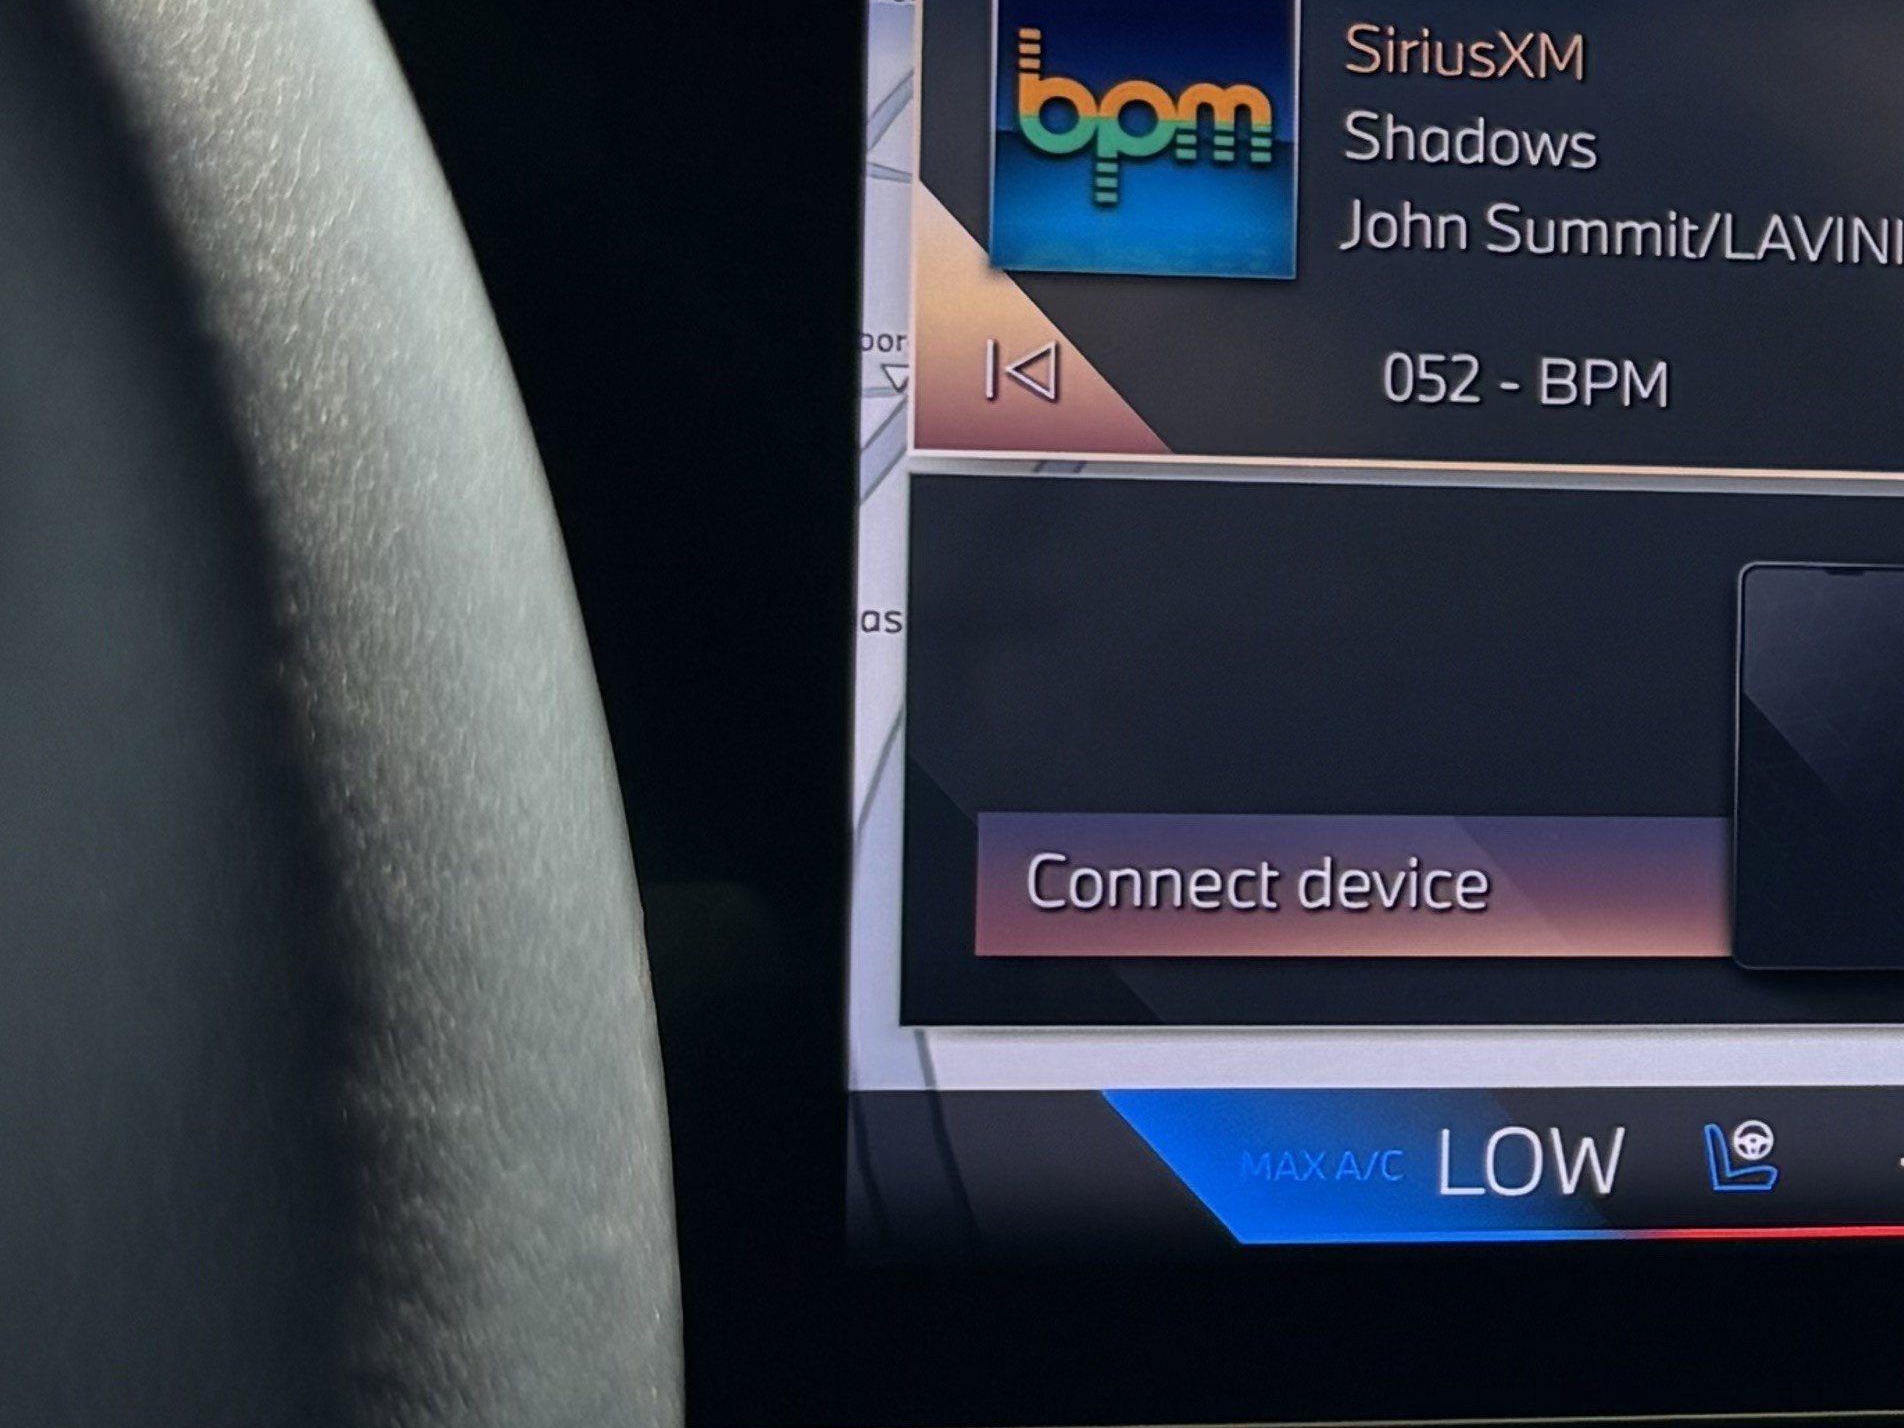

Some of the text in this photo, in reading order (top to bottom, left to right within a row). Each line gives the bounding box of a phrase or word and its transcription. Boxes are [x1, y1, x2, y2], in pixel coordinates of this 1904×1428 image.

[1345, 22, 1584, 81] SiriusXM
[1018, 27, 1272, 203] bpm
[1345, 110, 1598, 169] Shadows
[1340, 199, 1468, 251] John
[1384, 352, 1481, 404] 052
[1540, 357, 1669, 409] BPM
[1027, 852, 1489, 909] Connect device
[1241, 1149, 1404, 1181] MAX A/C
[1440, 1125, 1626, 1197] LOW
